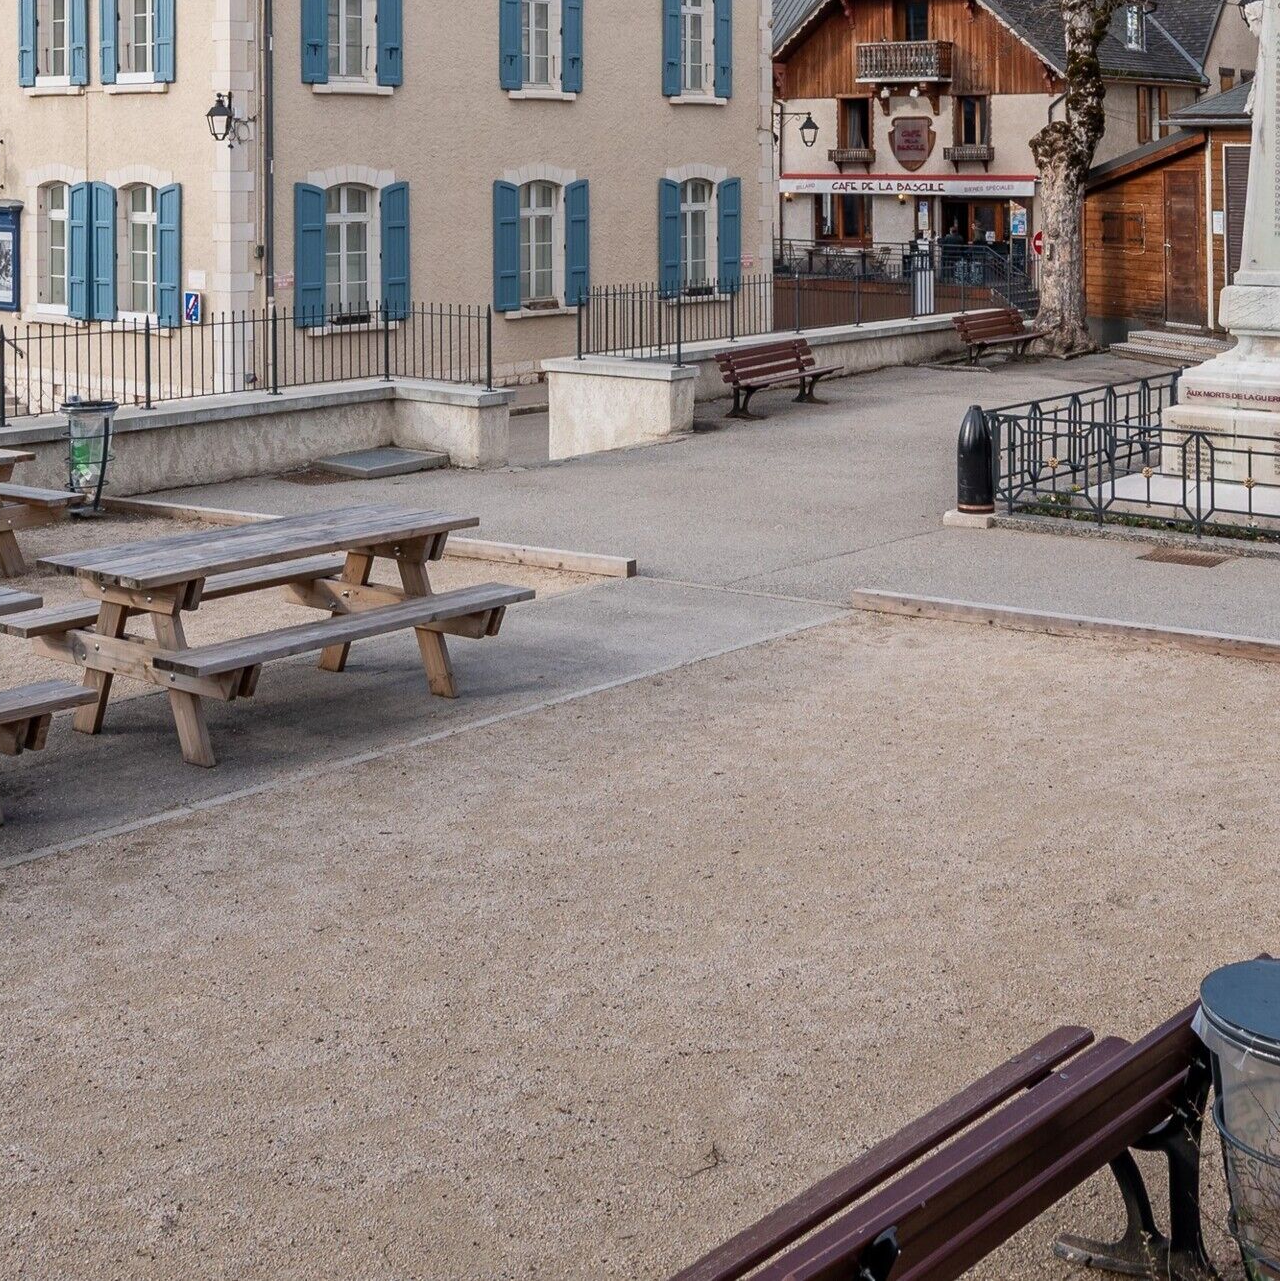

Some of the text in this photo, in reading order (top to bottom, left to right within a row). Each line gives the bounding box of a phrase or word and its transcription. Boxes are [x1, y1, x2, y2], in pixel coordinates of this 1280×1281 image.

[832, 182, 858, 192] CAFE
[862, 182, 874, 191] DE
[879, 182, 893, 191] LA
[897, 183, 945, 192] BASCULE
[1203, 391, 1230, 399] MORTS
[1244, 393, 1254, 401] LA
